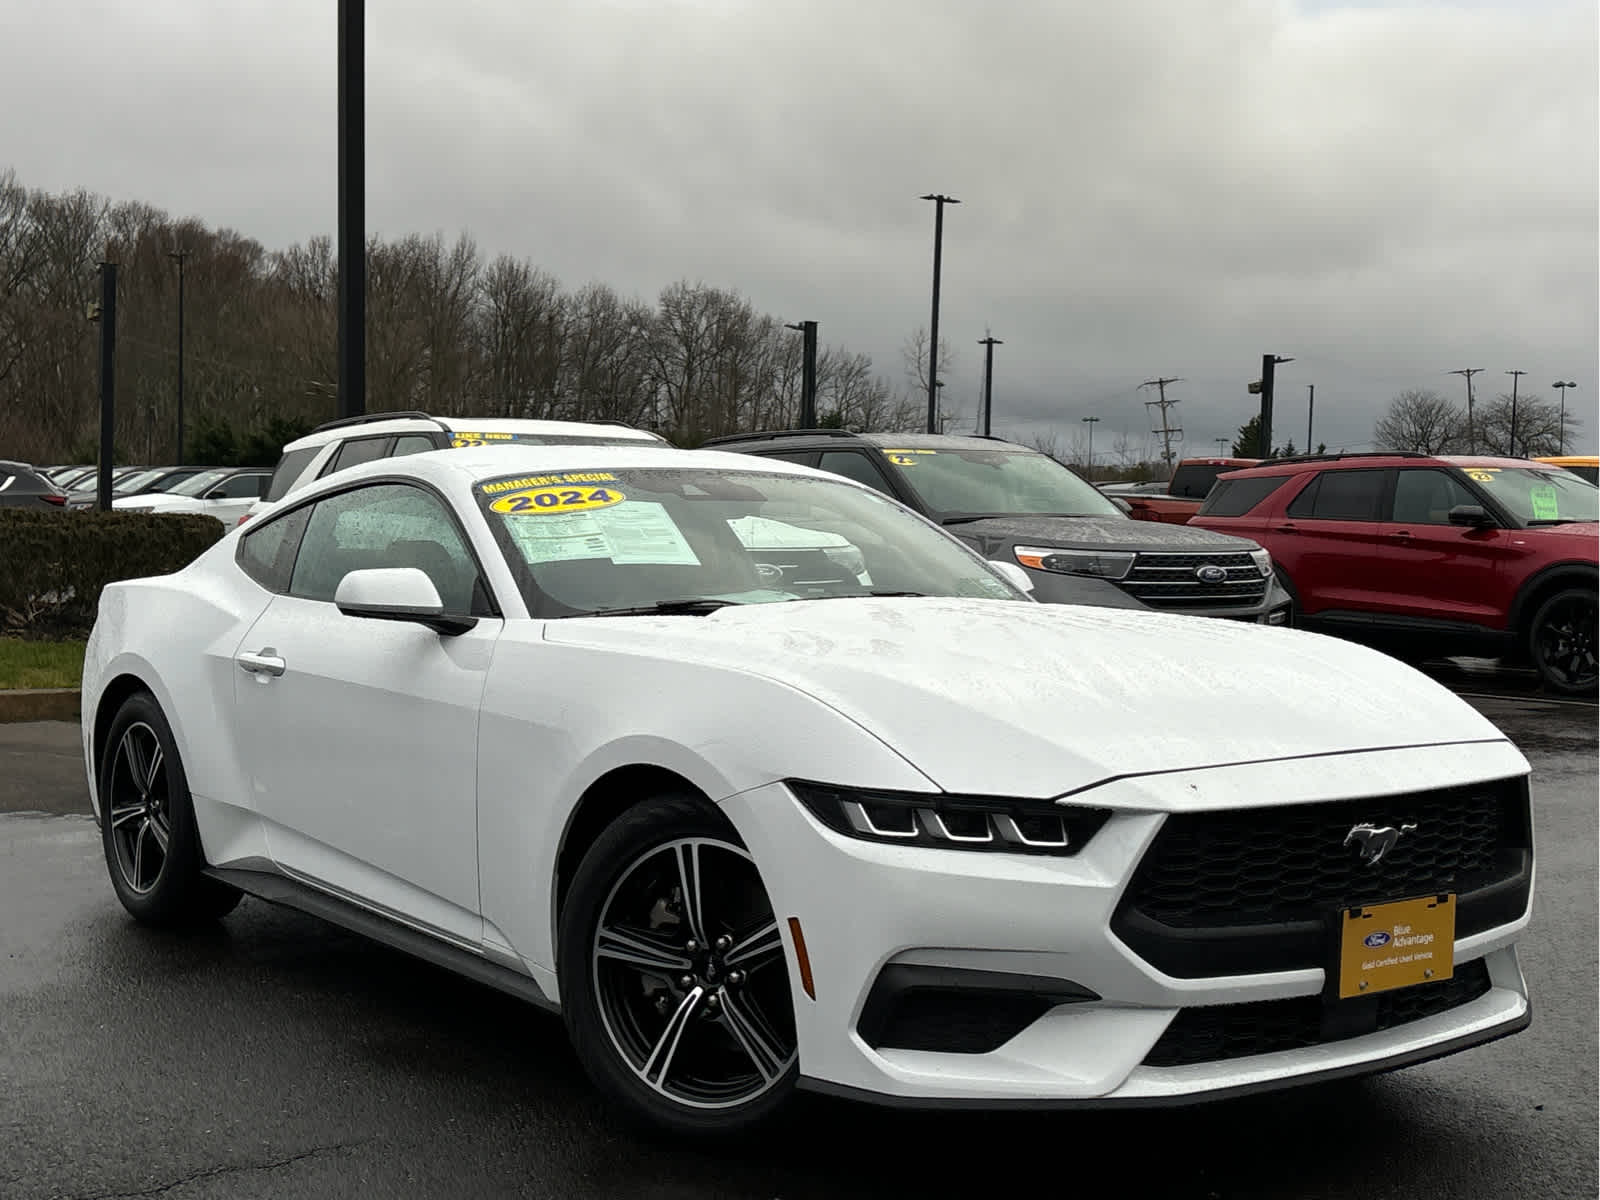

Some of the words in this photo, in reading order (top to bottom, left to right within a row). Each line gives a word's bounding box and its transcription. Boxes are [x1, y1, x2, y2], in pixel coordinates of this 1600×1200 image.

[482, 475, 560, 494] MANAGER'S
[563, 472, 617, 483] SPECIAL
[507, 488, 615, 512] 2024
[1393, 925, 1411, 936] Blue
[1367, 933, 1387, 947] Ford
[1392, 934, 1433, 948] Advantage
[1362, 960, 1375, 970] Gold
[1376, 956, 1398, 967] Certified
[1399, 954, 1413, 963] Used
[1414, 952, 1433, 961] Vehicle
